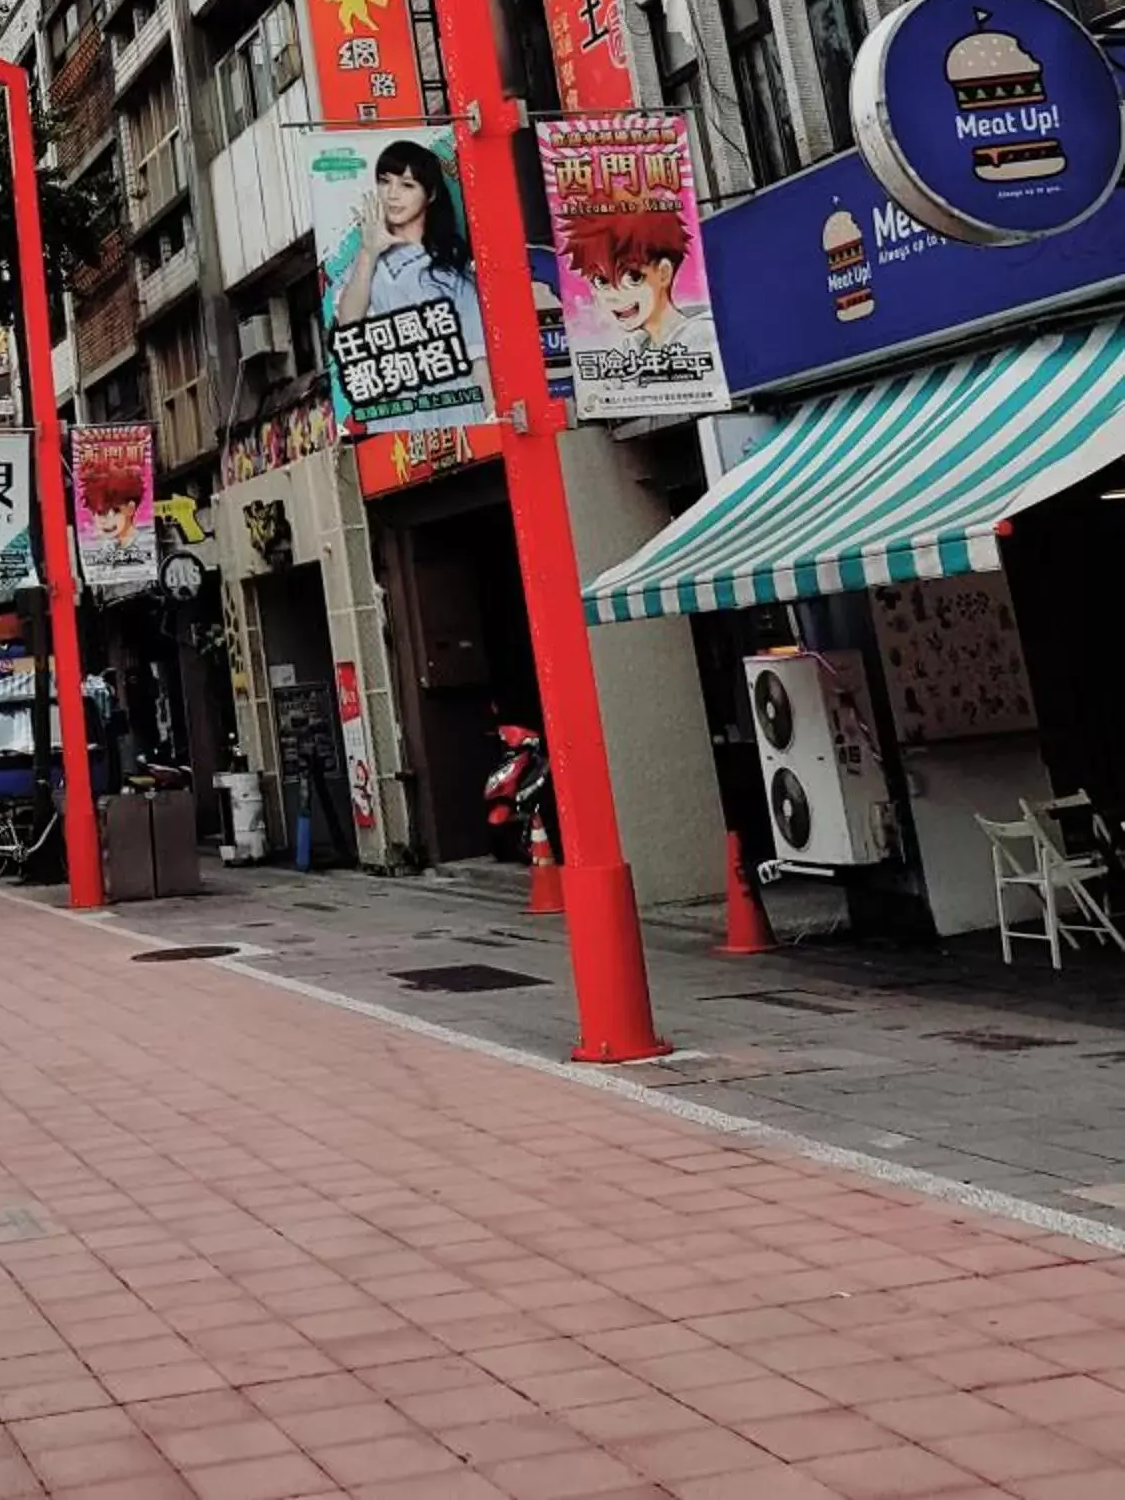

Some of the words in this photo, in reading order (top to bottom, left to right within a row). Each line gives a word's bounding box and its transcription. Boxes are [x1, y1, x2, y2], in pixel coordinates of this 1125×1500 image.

[955, 111, 1017, 139] Meat
[1021, 104, 1060, 136] Up!
[552, 152, 682, 197] 西門町
[333, 303, 459, 364] 任何風格
[344, 338, 470, 402] 都夠格!
